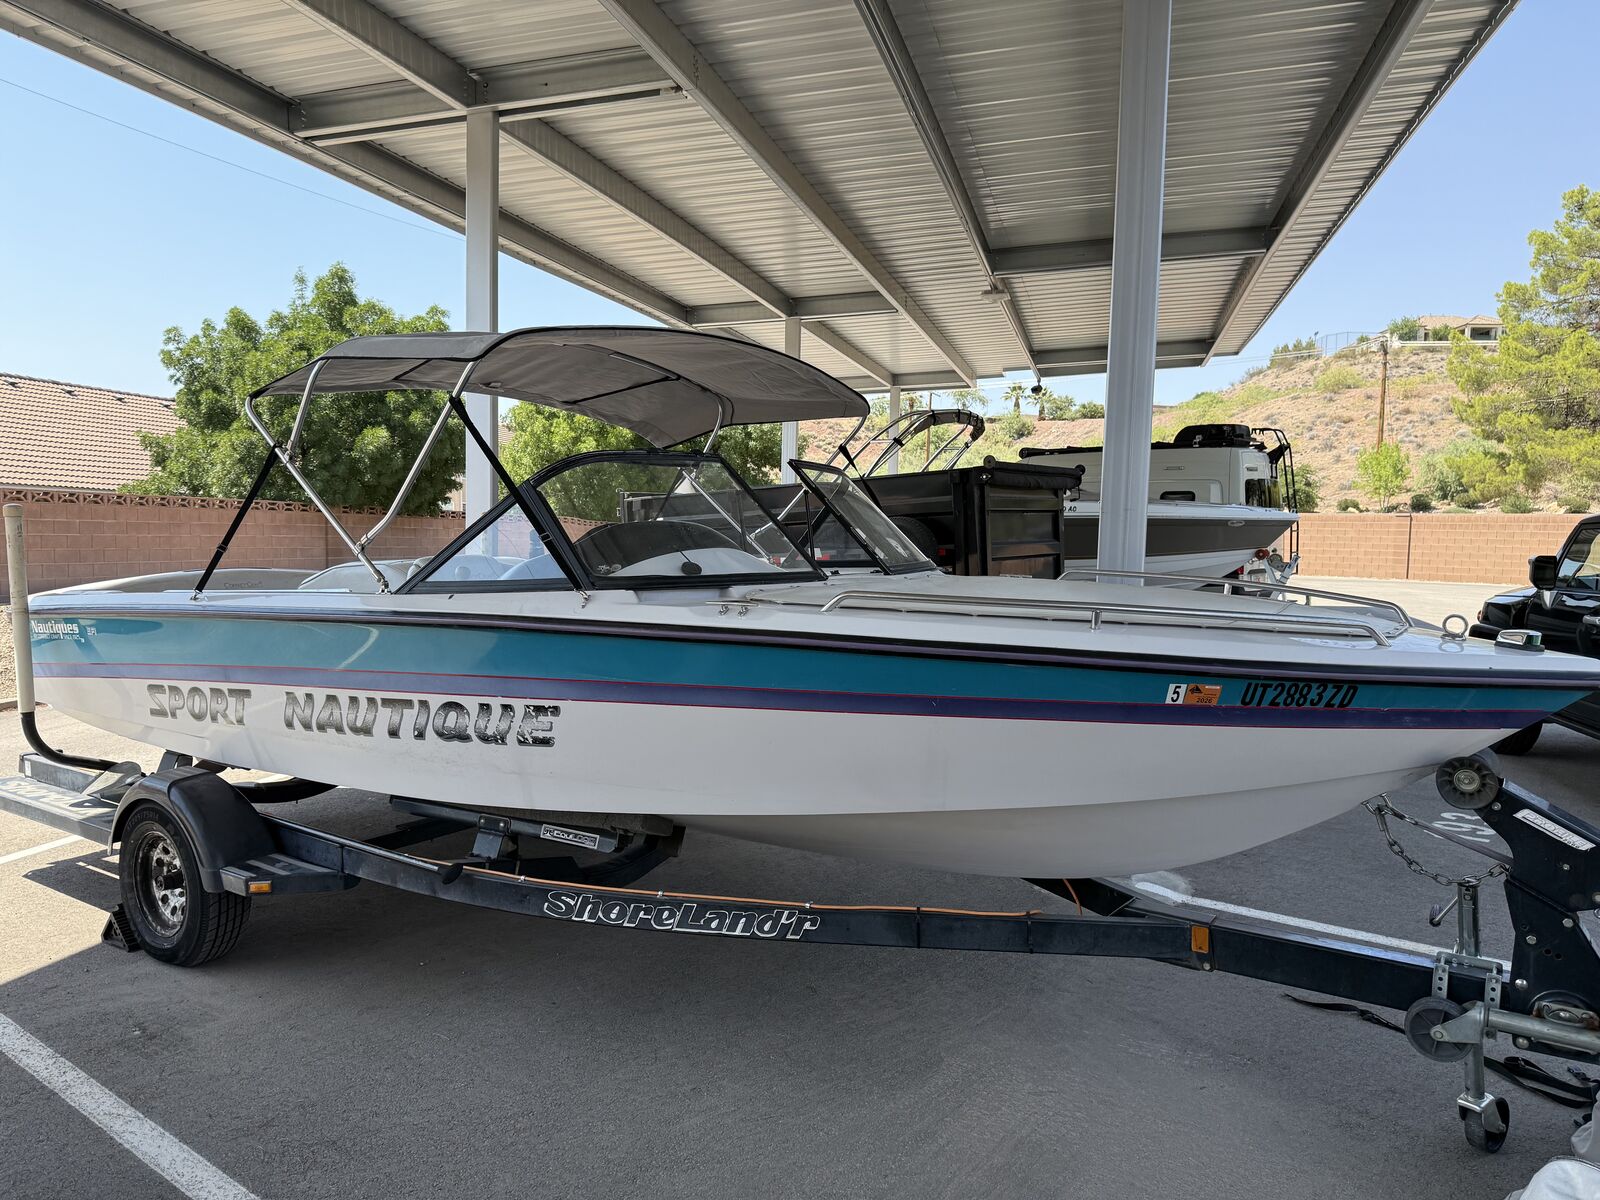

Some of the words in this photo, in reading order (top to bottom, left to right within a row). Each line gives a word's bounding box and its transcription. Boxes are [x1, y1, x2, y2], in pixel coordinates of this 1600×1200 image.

[31, 620, 80, 640] Nautiques
[1170, 685, 1182, 703] 5
[147, 684, 252, 726] SPORT
[284, 691, 561, 748] NAUTIQUE
[544, 890, 820, 940] ShoreLand'r
